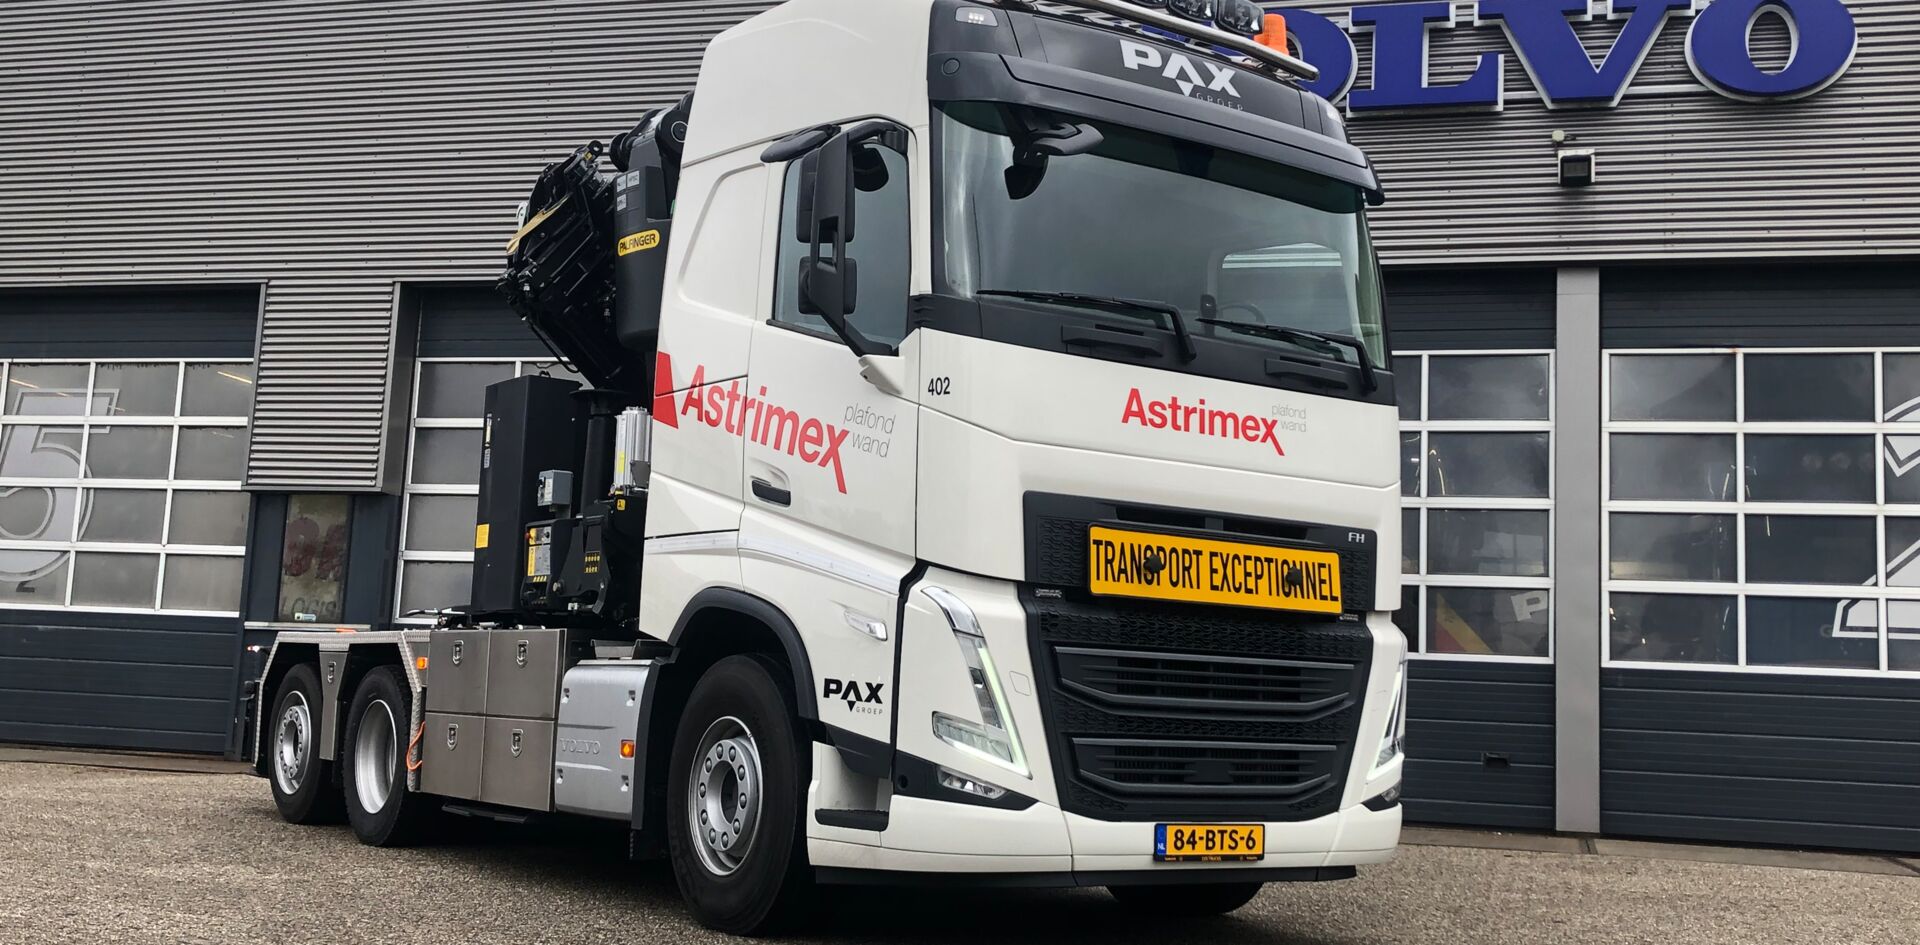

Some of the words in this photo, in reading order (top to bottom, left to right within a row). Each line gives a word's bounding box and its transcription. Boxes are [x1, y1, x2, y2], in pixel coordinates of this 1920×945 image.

[1120, 39, 1241, 98] PAX
[619, 233, 657, 253] PALFINGER
[927, 377, 951, 396] 402
[844, 403, 896, 435] plafond
[1121, 387, 1285, 456] Astrimex
[1272, 403, 1306, 420] plafond
[681, 364, 849, 495] Astrimex
[1281, 420, 1307, 433] wand
[852, 433, 890, 458] wand
[1348, 533, 1365, 544] FH
[1092, 539, 1203, 590] TRANSPORT
[823, 678, 884, 704] PAX
[855, 706, 883, 715] GROEP
[1173, 829, 1256, 850] 84-BTS-6
